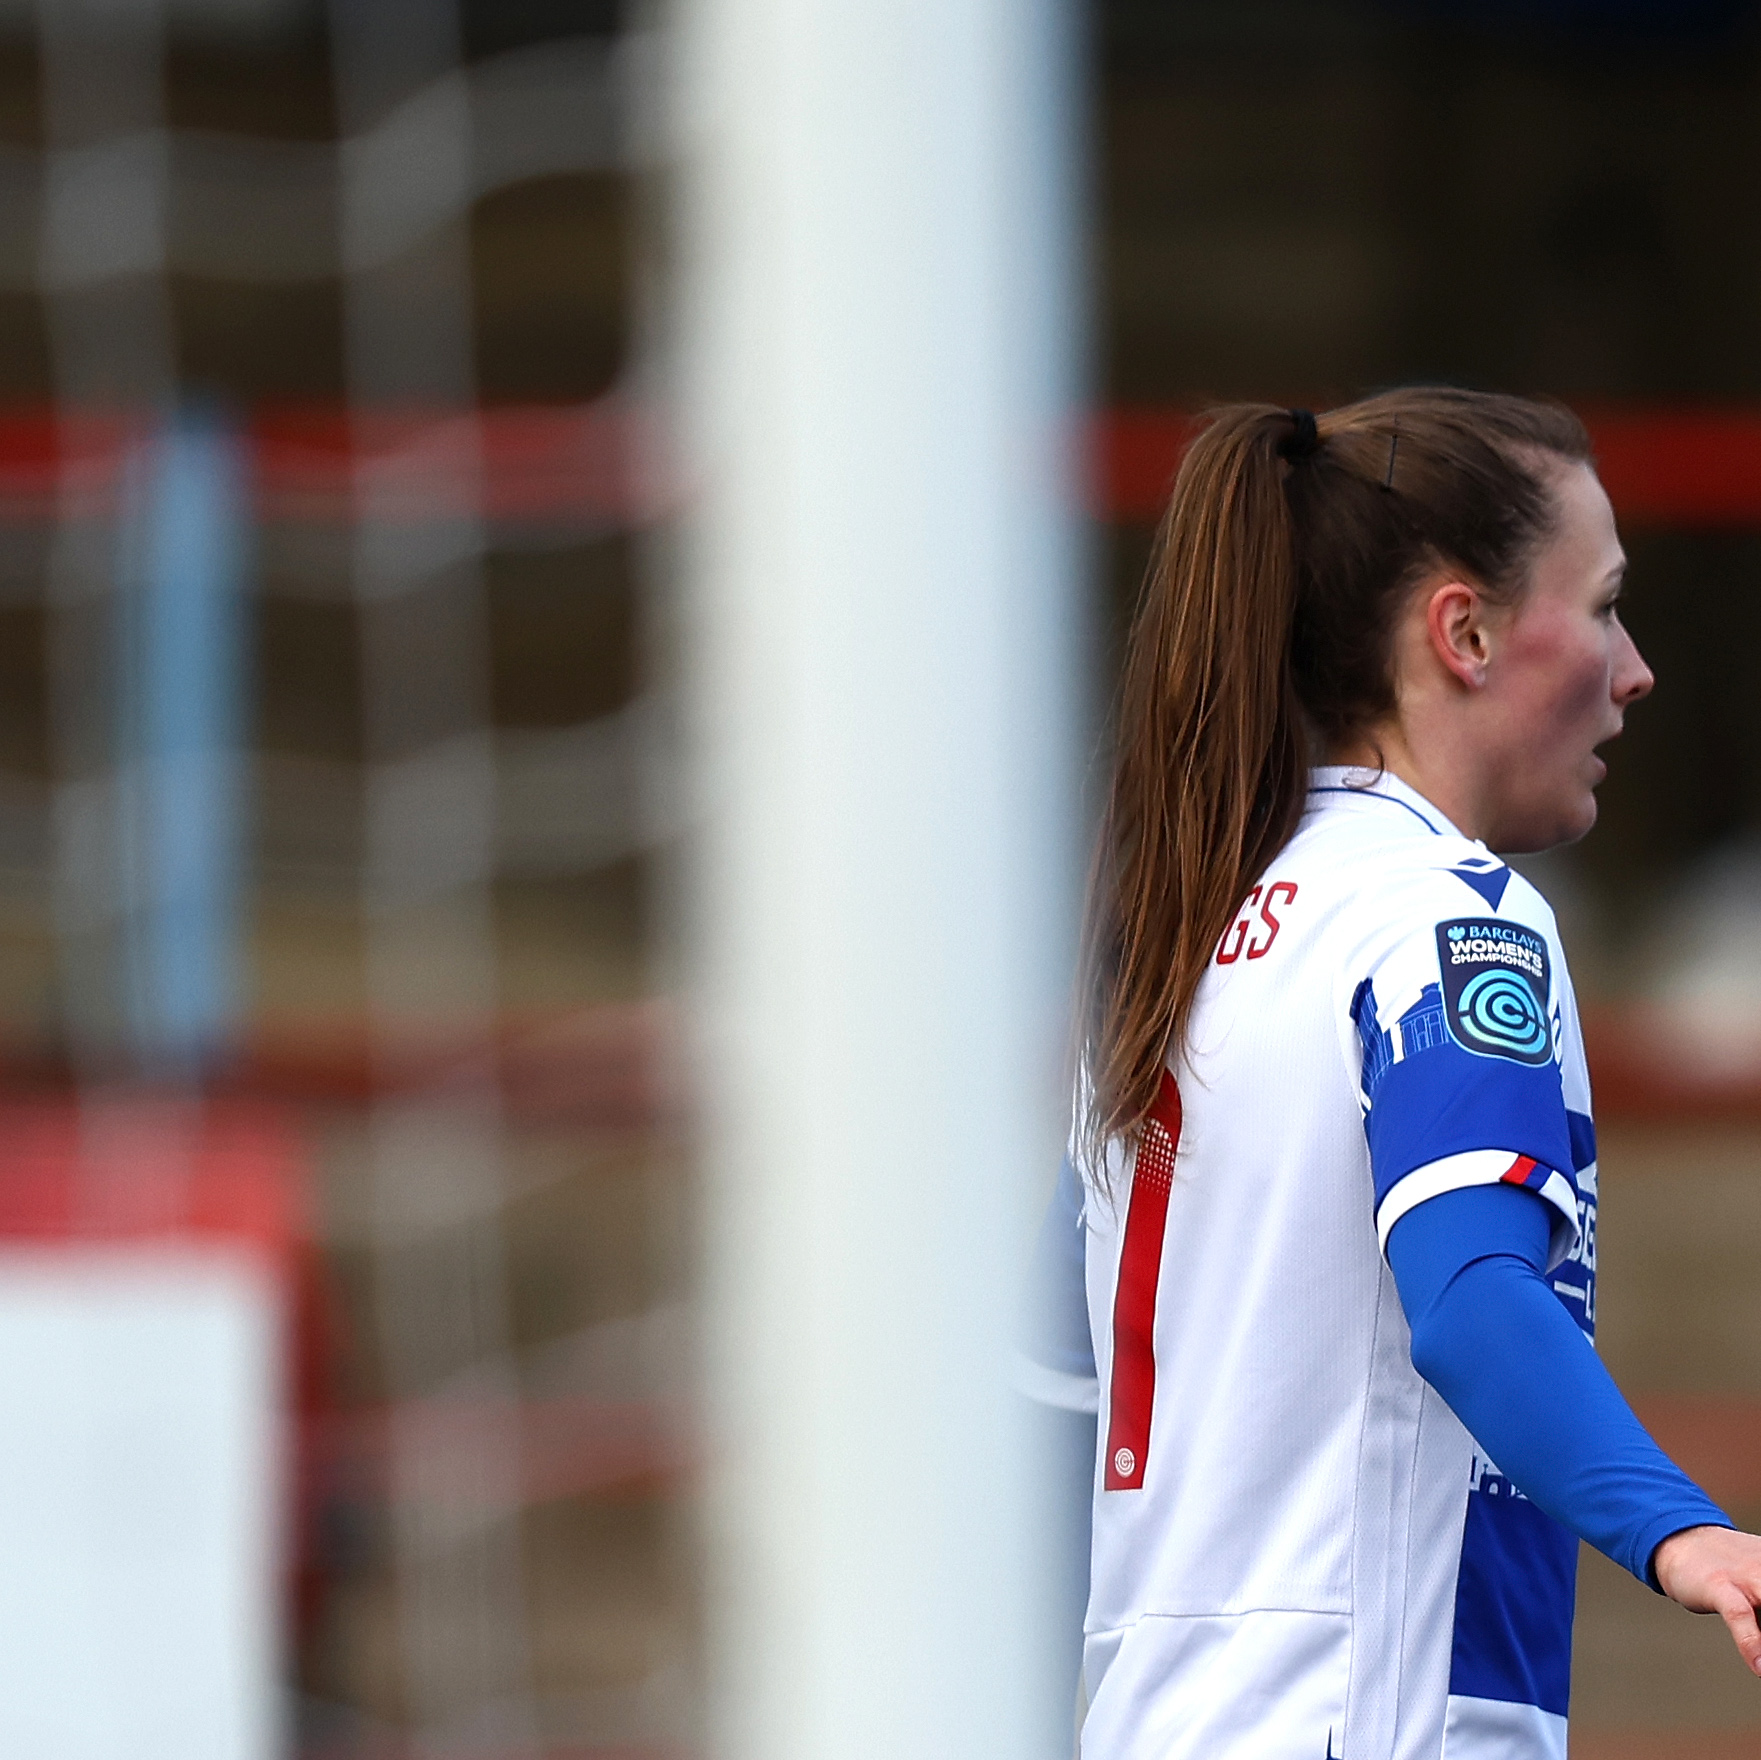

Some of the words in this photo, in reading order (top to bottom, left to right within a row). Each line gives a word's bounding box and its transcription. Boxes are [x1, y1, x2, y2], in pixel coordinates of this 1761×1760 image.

[1215, 881, 1299, 965] GS
[1448, 938, 1544, 970] WOMEN'S
[1468, 925, 1543, 954] BARCLAYS
[1450, 951, 1544, 978] CHAMPIONSHIP
